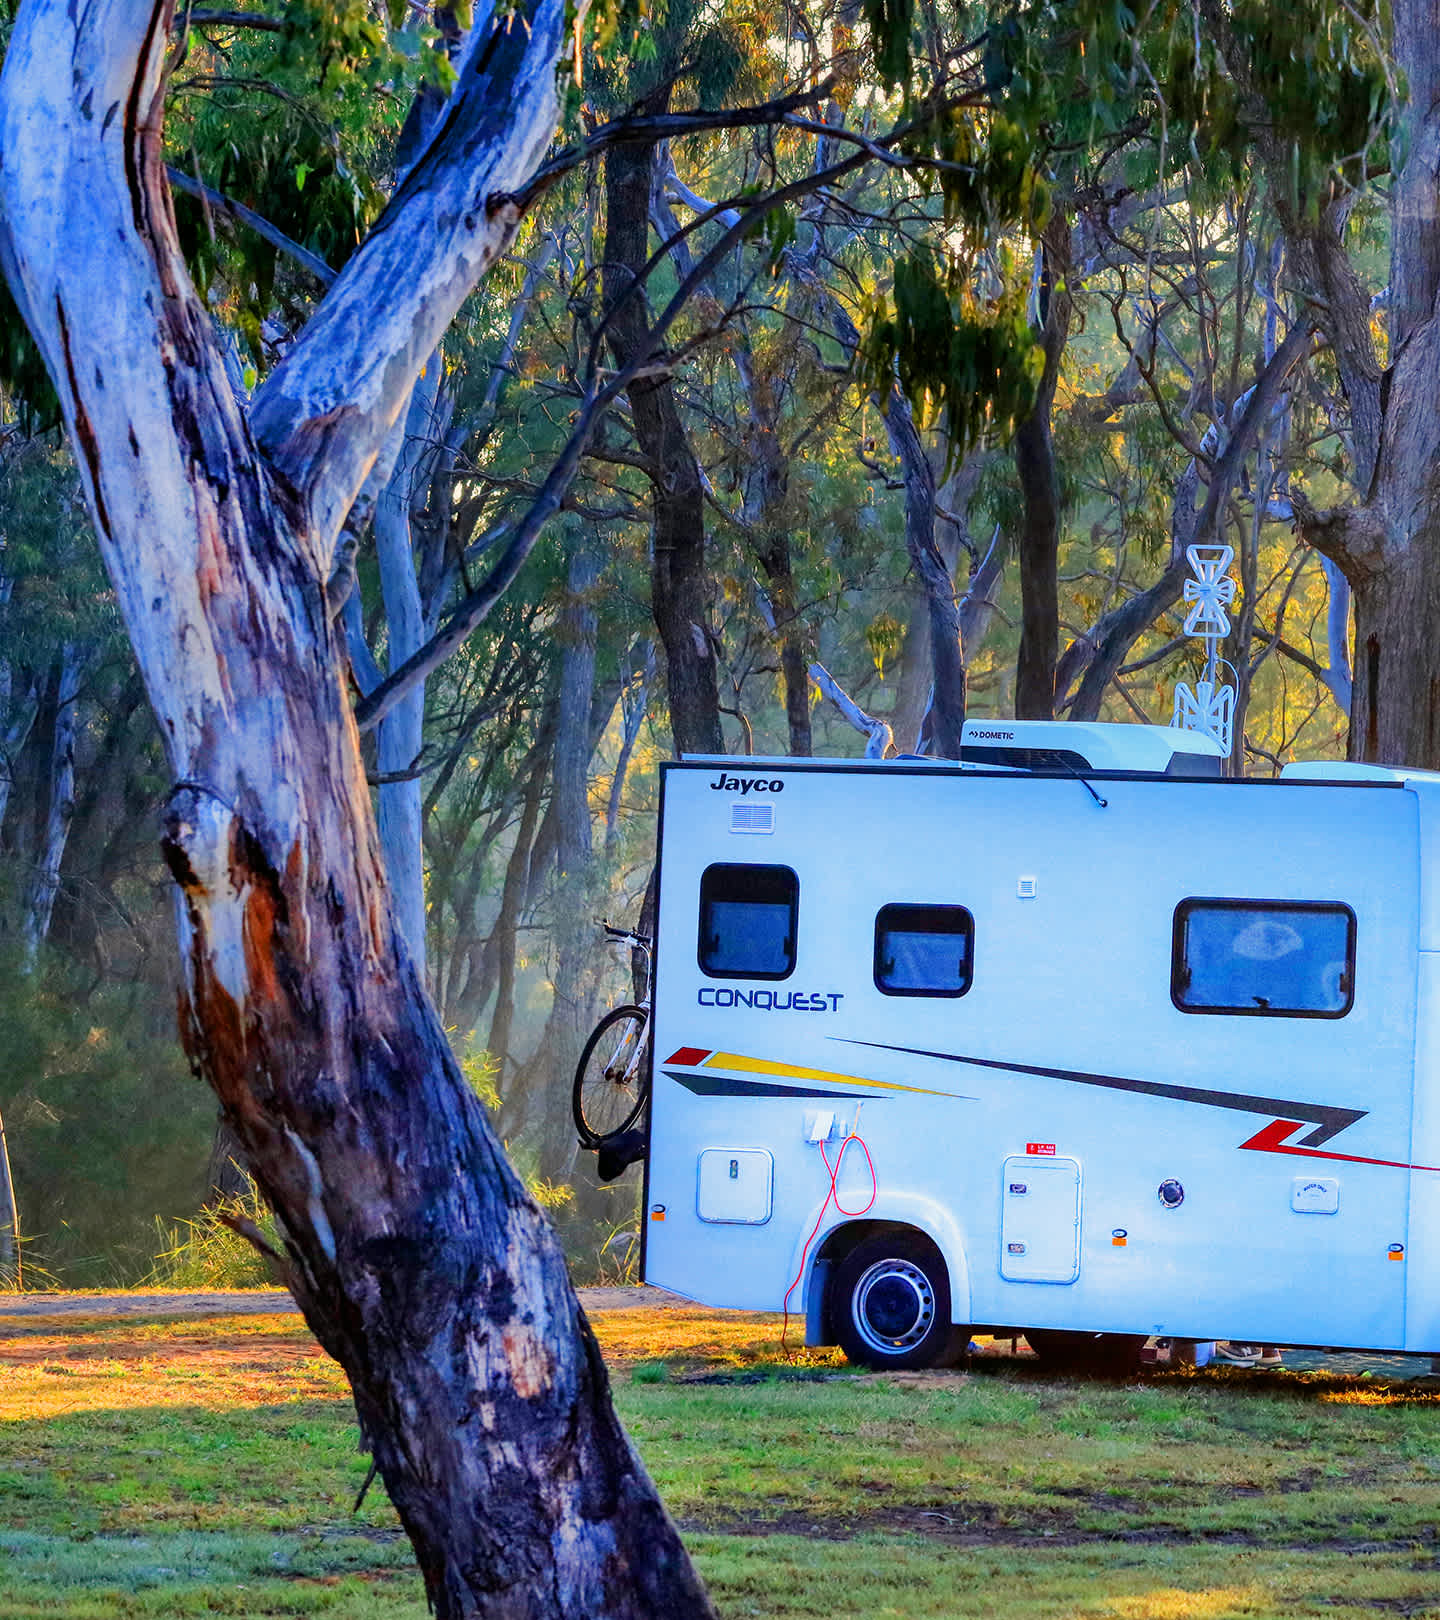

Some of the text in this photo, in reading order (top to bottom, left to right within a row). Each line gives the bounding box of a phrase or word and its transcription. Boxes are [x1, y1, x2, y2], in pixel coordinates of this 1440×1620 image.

[979, 730, 1015, 740] DOMETIC
[710, 773, 785, 795] Jayco
[697, 987, 844, 1012] CONQUEST
